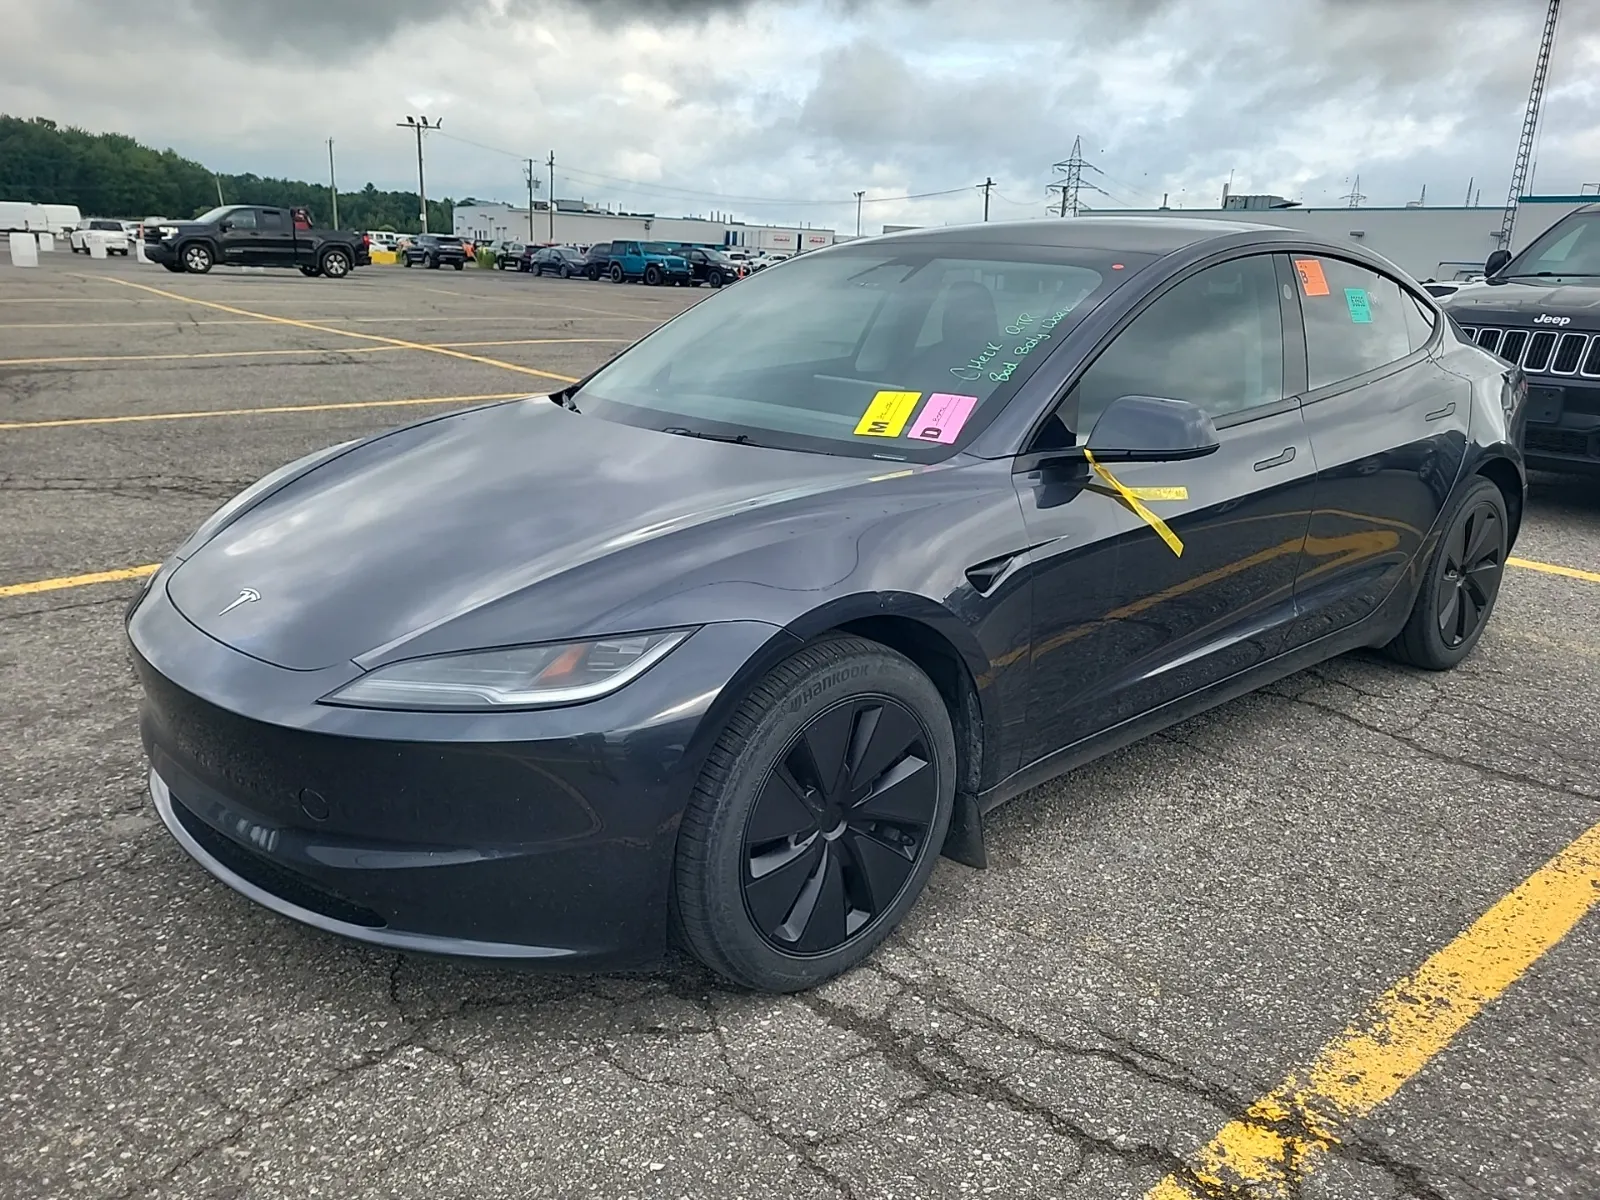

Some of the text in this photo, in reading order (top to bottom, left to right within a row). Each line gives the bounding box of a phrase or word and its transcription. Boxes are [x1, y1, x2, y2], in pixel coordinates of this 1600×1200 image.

[1299, 269, 1309, 284] B
[1533, 313, 1571, 326] Jeep
[988, 361, 1019, 382] Bad
[1013, 333, 1052, 355] Body
[867, 421, 890, 433] M
[919, 426, 943, 439] D
